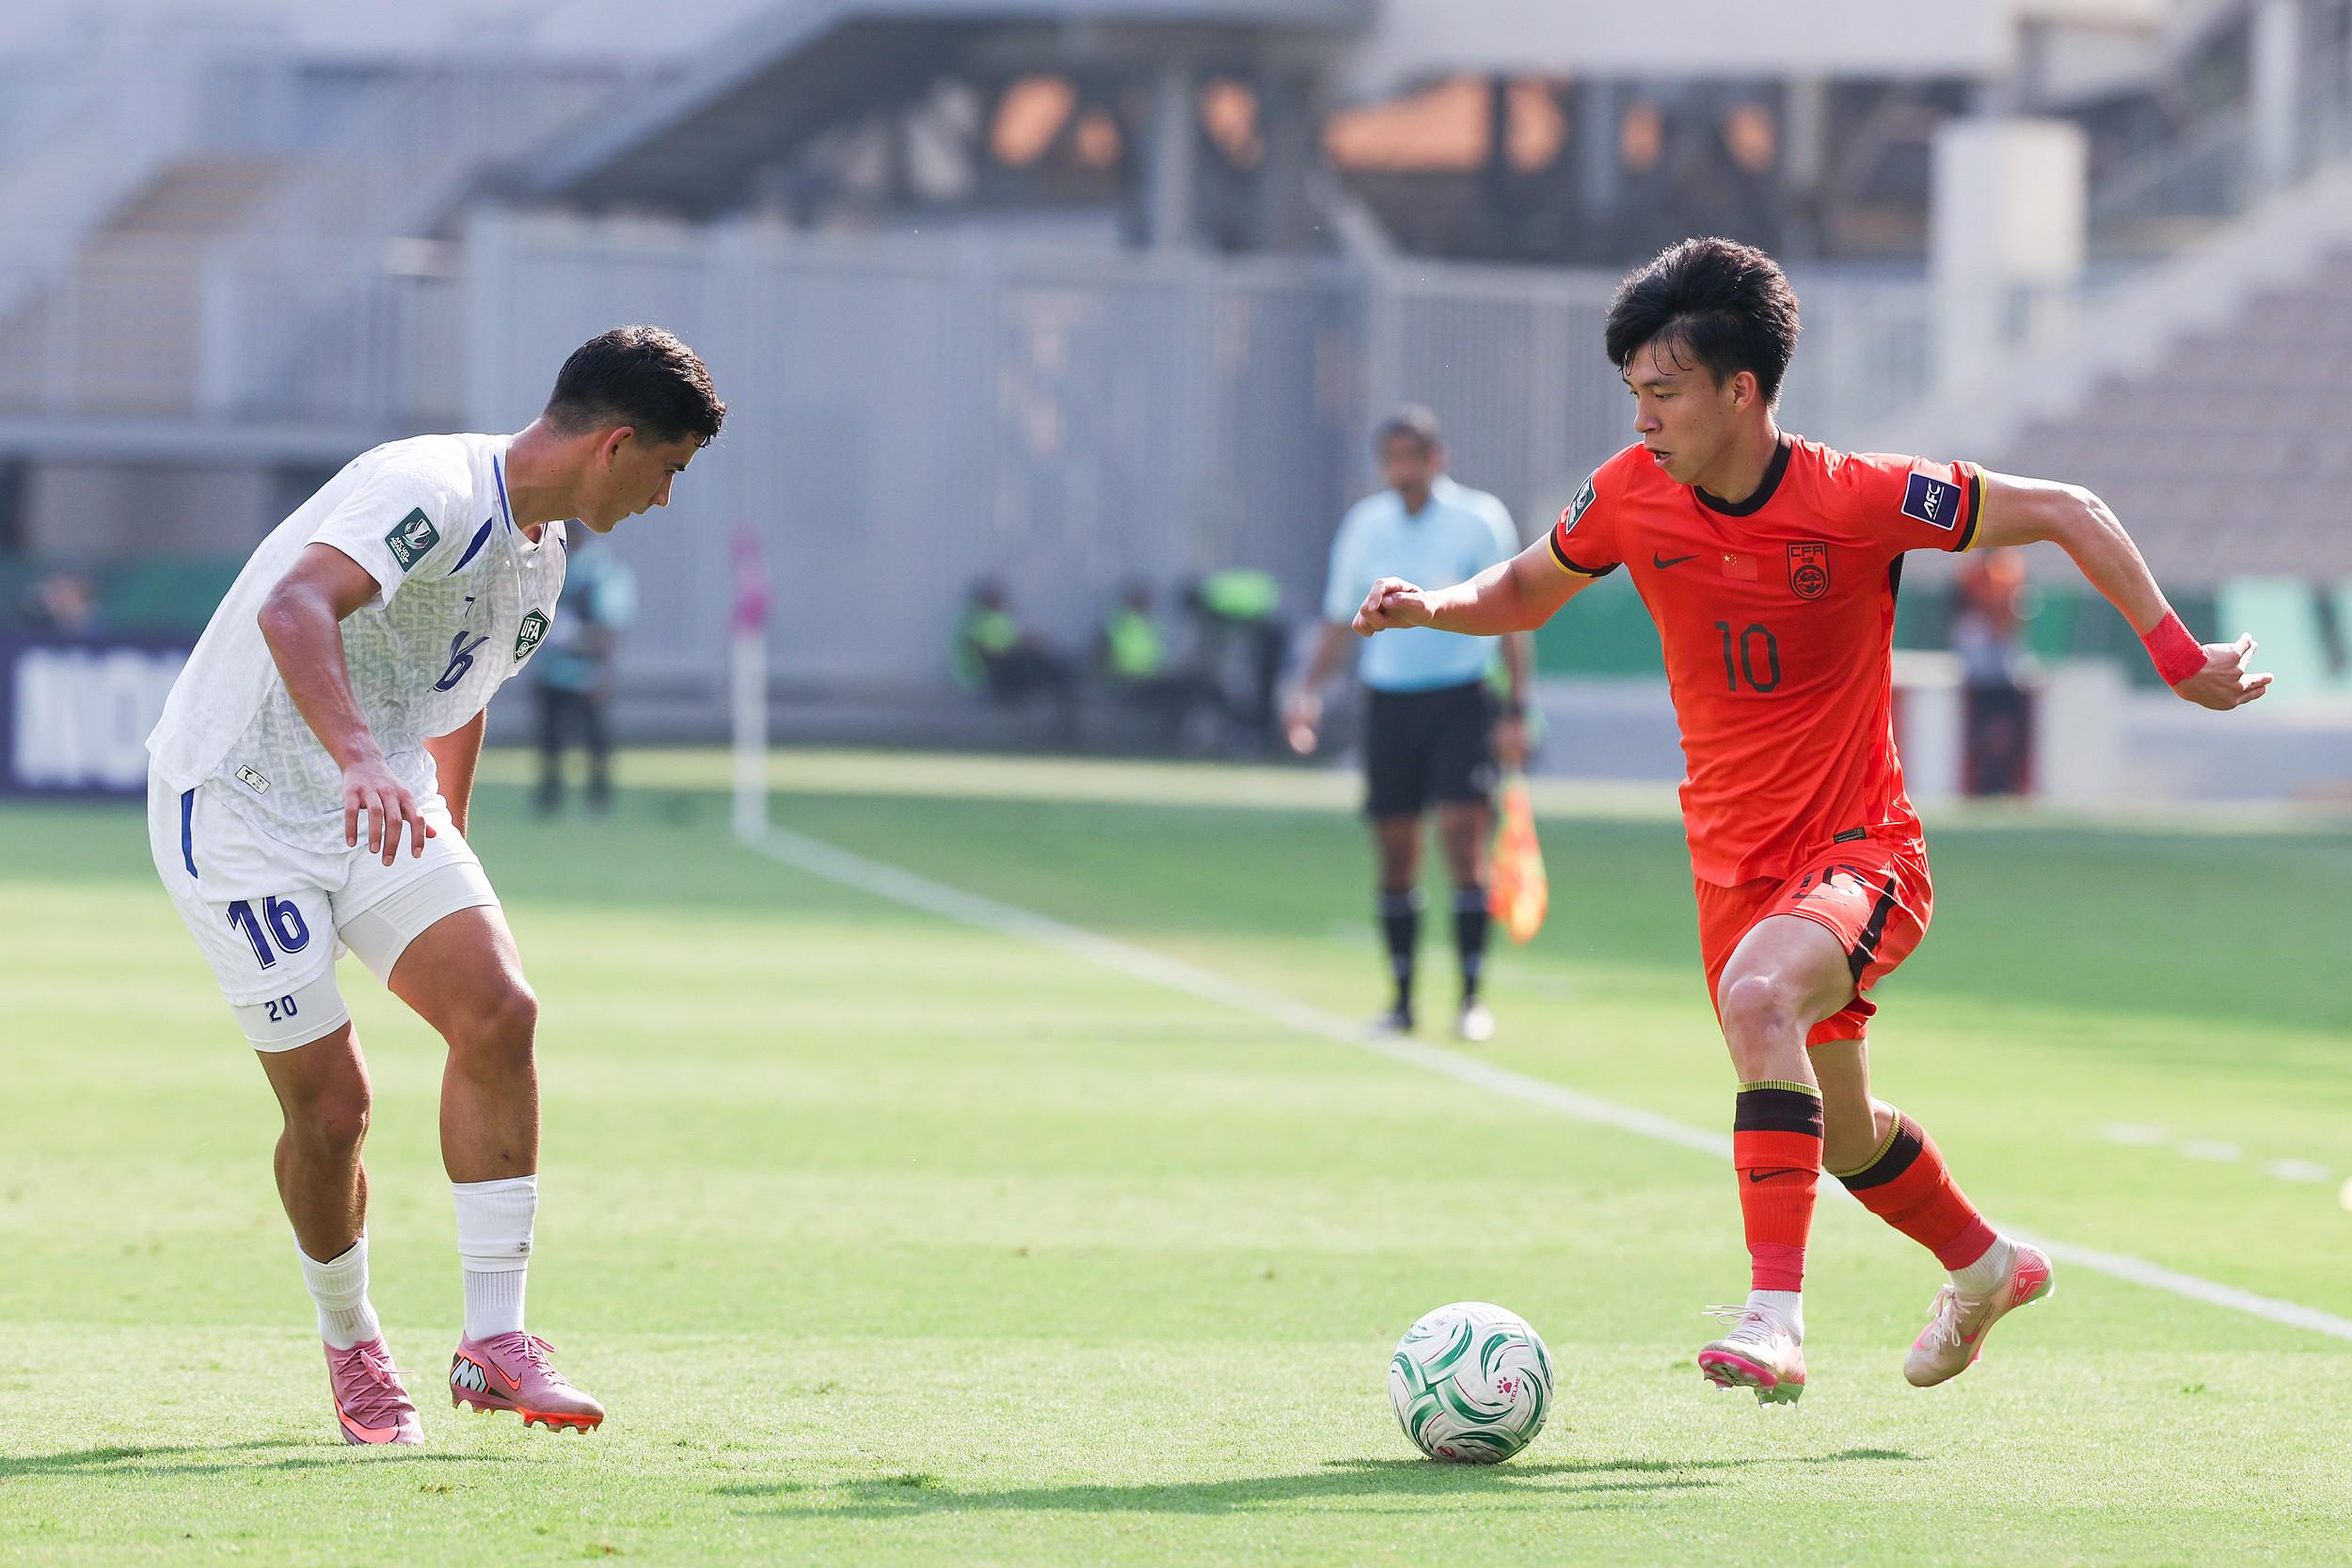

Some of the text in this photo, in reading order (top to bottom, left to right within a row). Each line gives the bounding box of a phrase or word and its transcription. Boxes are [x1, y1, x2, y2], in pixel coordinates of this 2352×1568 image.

[1923, 480, 1941, 519] AFC
[1791, 546, 1823, 557] CFA
[520, 620, 541, 640] UFA
[1715, 621, 1781, 692] 10
[226, 895, 310, 970] 16
[264, 994, 297, 1023] 20
[1509, 1376, 1520, 1403] KELME
